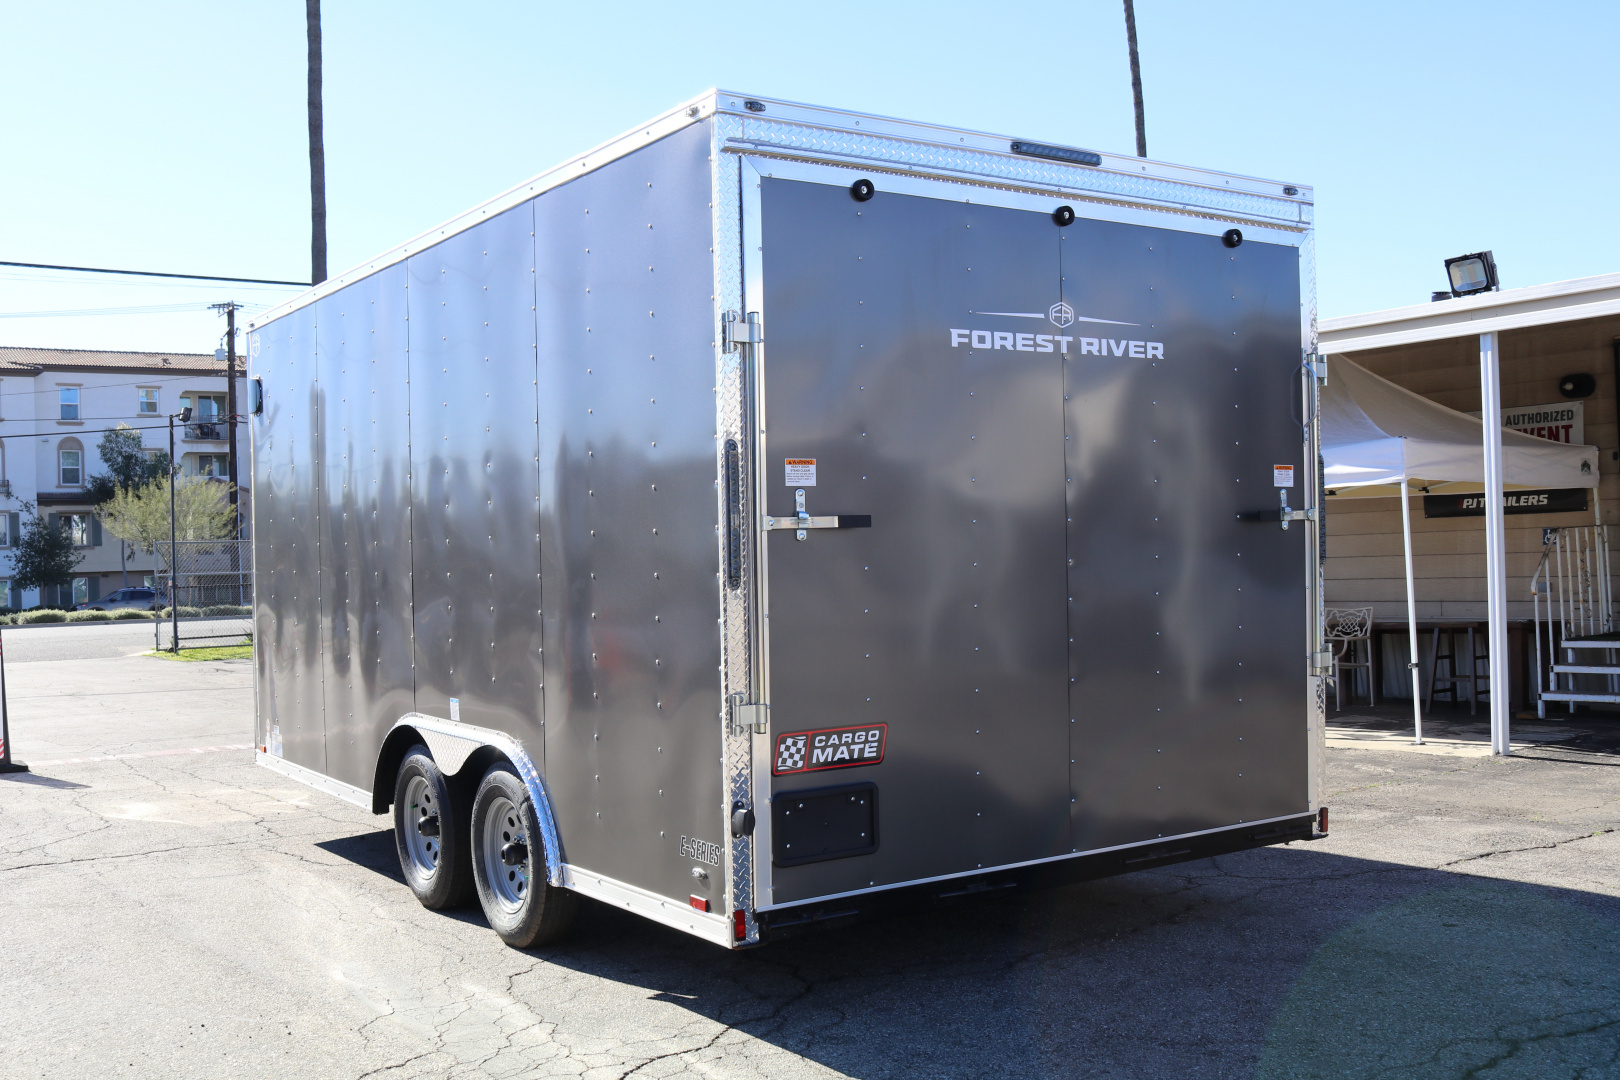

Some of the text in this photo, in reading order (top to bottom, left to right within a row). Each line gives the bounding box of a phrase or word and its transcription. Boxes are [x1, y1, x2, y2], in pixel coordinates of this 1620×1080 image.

[950, 328, 1164, 359] FOREST RIVER
[1505, 409, 1574, 426] AUTHORIZED
[1463, 498, 1478, 509] PJ
[814, 730, 880, 747] CARGO
[812, 742, 878, 764] MATE
[680, 835, 720, 866] E-SERIES
